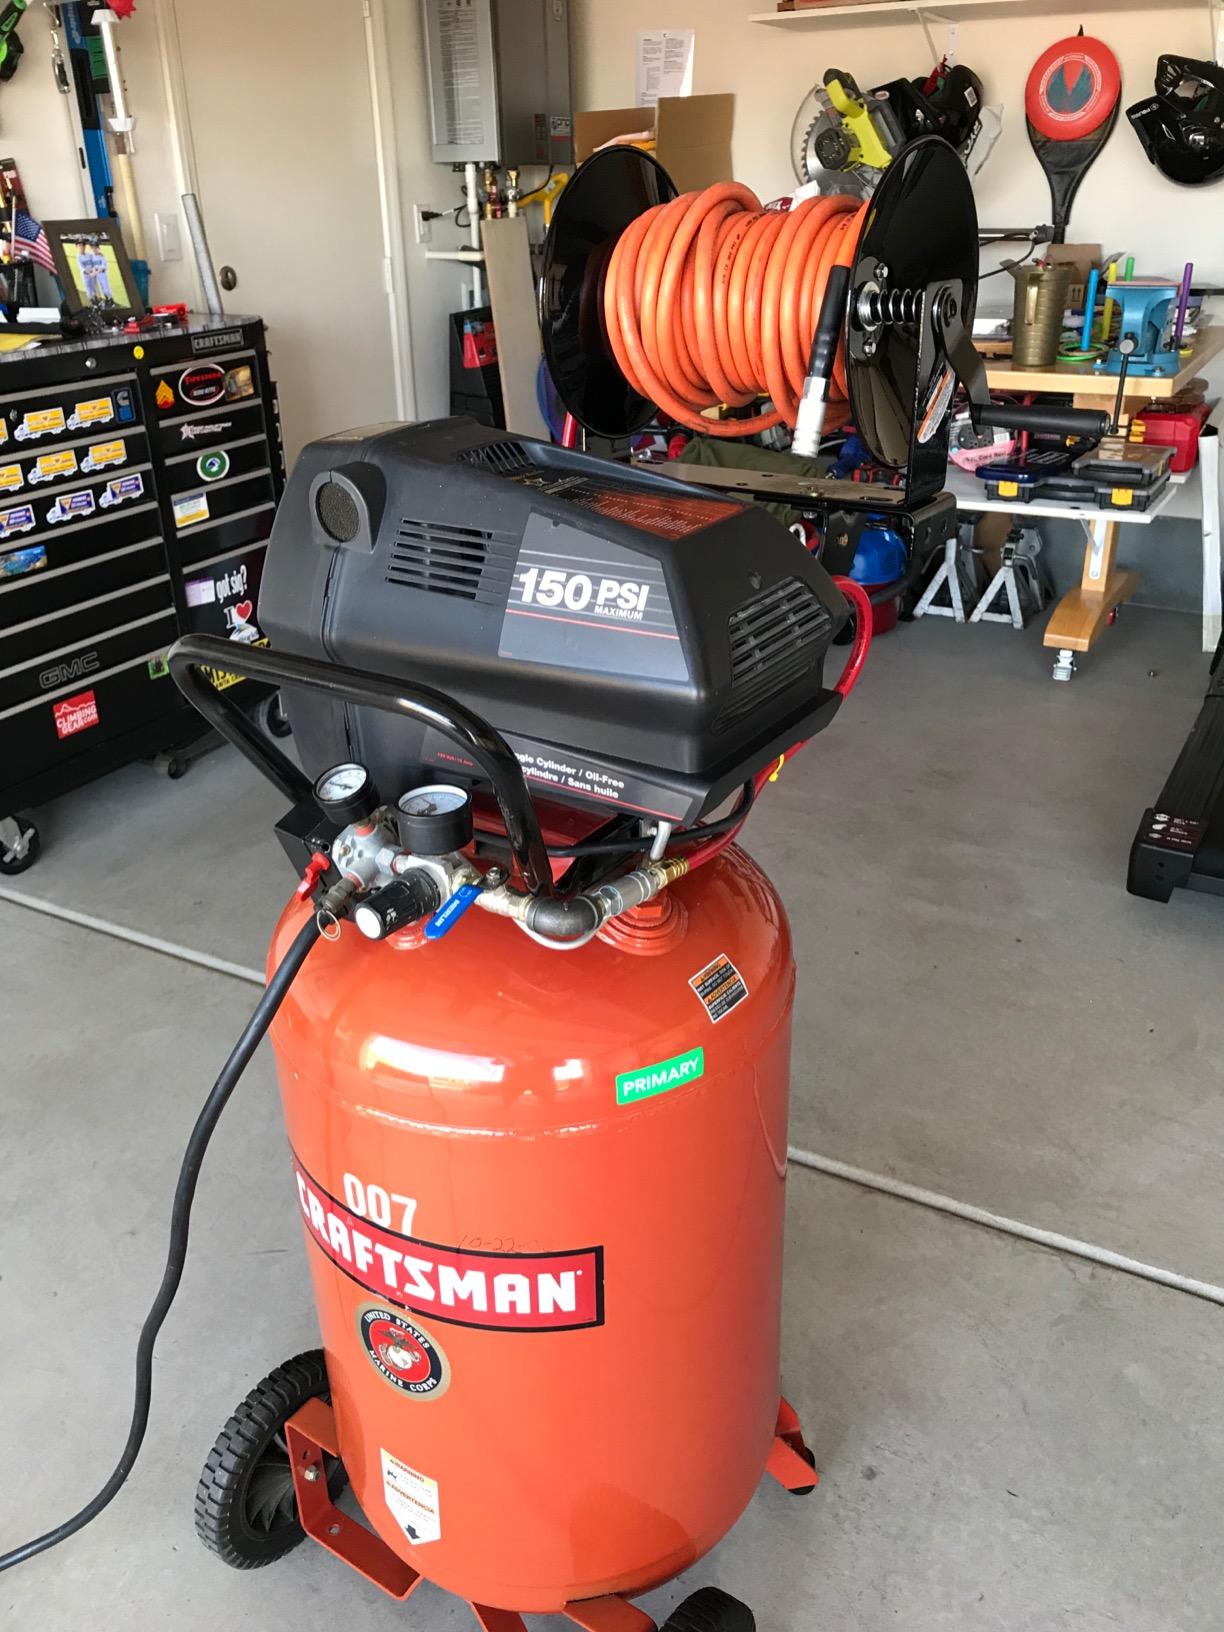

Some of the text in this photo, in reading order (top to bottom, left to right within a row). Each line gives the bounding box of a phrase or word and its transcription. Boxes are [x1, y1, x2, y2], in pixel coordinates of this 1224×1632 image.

[194, 332, 242, 349] CRAFTSMAN
[215, 573, 232, 604] got
[517, 567, 650, 612] 150 PSI
[593, 604, 644, 622] MAXIMUM
[39, 651, 101, 689] GMC
[514, 752, 626, 790] ngle Cylinder / Oil-Free
[567, 777, 592, 792] Sans
[593, 783, 620, 800] huile
[623, 1057, 699, 1097] PRIMARY
[342, 1171, 418, 1237] 007
[295, 1170, 577, 1314] CRAFTSMAN
[364, 1310, 431, 1350] UNITED STATES
[369, 1349, 438, 1393] MARINE CORPS
